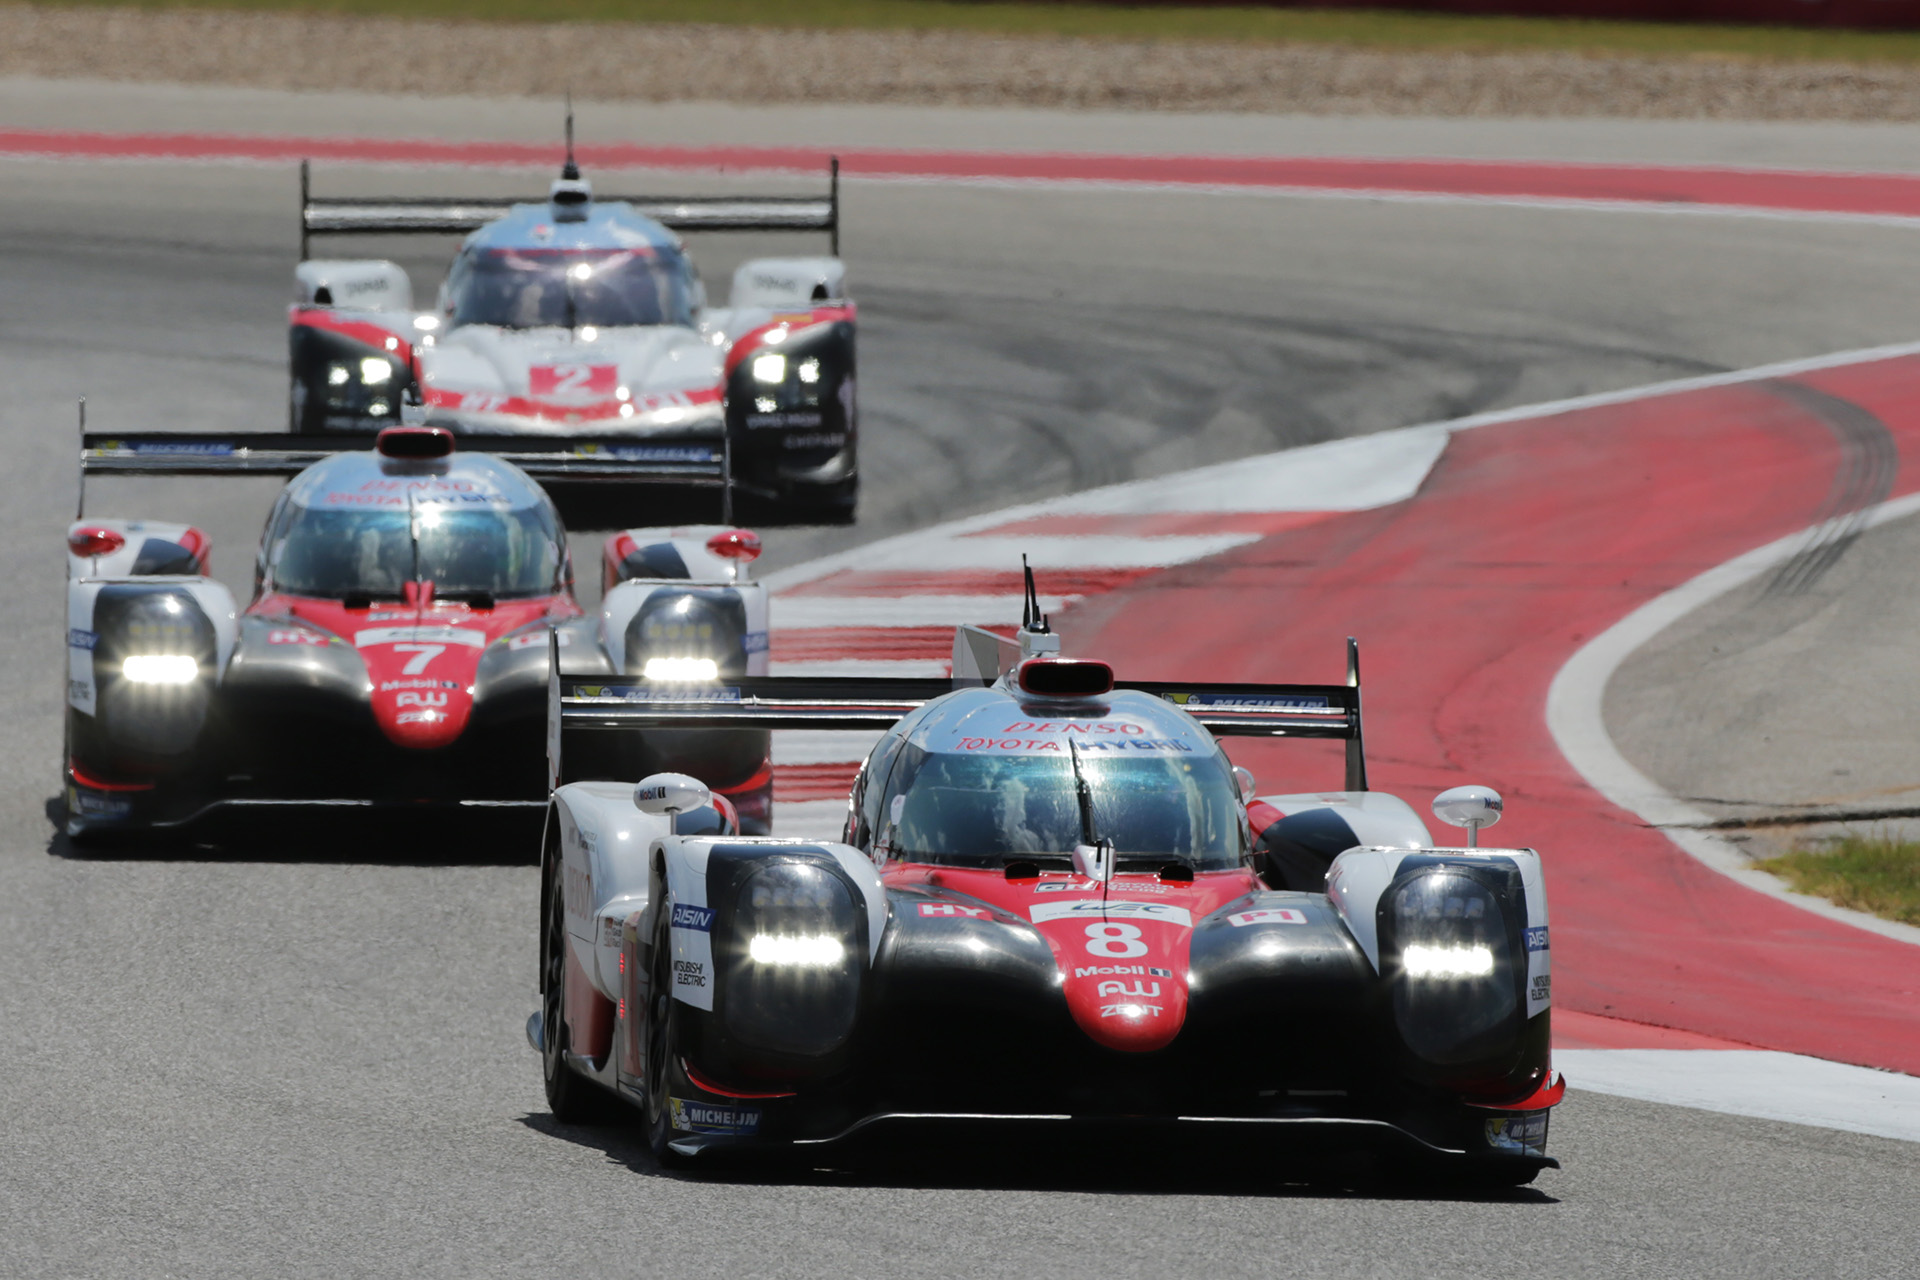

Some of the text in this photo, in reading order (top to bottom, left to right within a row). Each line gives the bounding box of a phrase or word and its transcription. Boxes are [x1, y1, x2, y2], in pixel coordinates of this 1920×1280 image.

[554, 364, 593, 395] 2
[359, 480, 473, 492] DENSO
[394, 644, 446, 675] 7
[381, 678, 438, 691] Mobil
[626, 691, 737, 700] MICHELIN
[1212, 699, 1324, 708] MICHELIN
[396, 711, 448, 724] ZET
[1003, 722, 1144, 735] DENSO
[955, 737, 1193, 752] TOYOTA HYBRID
[922, 904, 986, 916] HY
[1071, 903, 1170, 914] WEC
[673, 908, 711, 927] AISIN
[1241, 911, 1293, 922] P1
[1084, 922, 1149, 958] 8
[674, 960, 703, 975] MITSUBISHI
[1075, 965, 1145, 978] Mobil
[678, 973, 707, 987] ELECTRIC
[691, 1109, 759, 1126] MICHELIN
